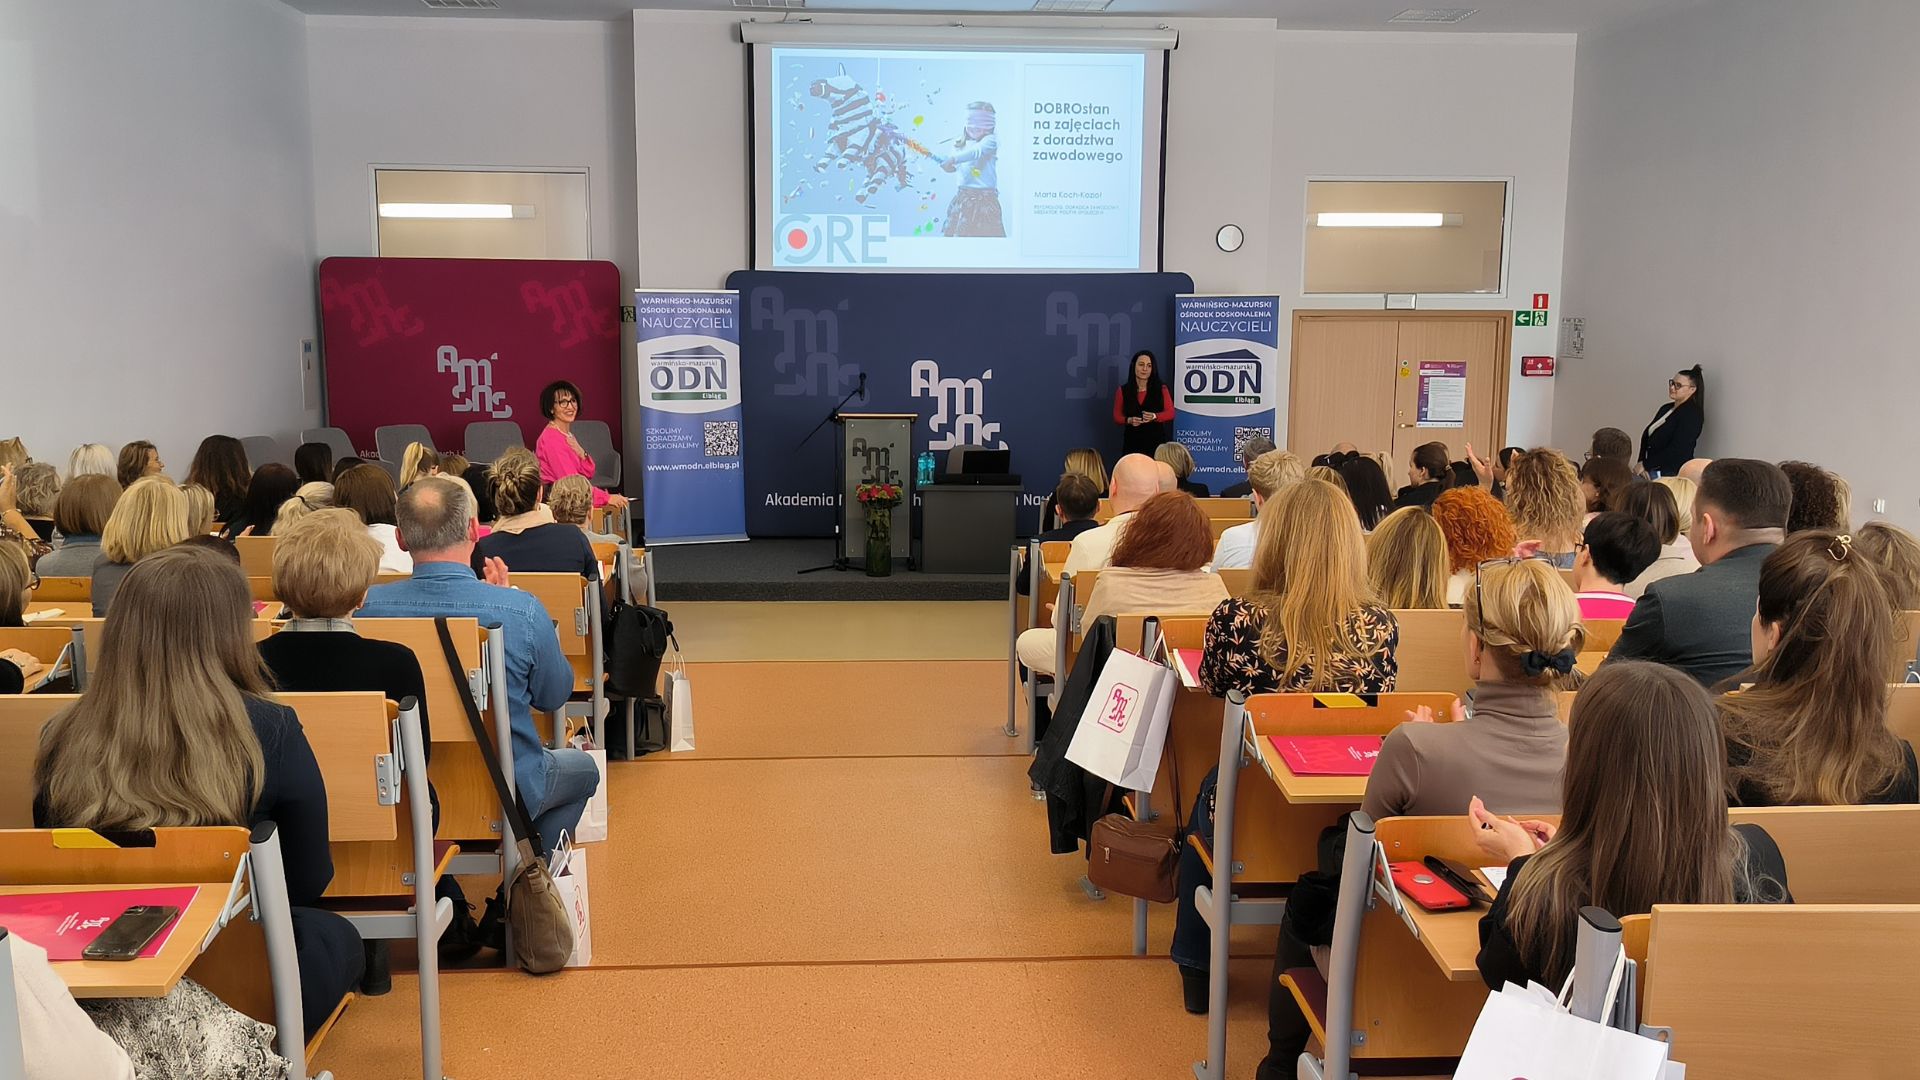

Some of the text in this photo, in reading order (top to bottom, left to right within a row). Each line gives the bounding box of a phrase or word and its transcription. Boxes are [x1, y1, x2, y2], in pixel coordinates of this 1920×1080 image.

[1033, 102, 1110, 114] DOBROstan
[1033, 118, 1120, 132] na zajęciach
[1032, 133, 1114, 145] z doradztwa
[1032, 149, 1123, 163] zawodowego
[774, 213, 888, 264] ORE
[641, 296, 732, 305] WARMIŃSKO-MAZURSKI
[1181, 301, 1272, 309] WARMIŃSKO-MAZURSKI
[642, 317, 733, 329] NAUCZYCIELI
[1180, 321, 1272, 333] NAUCZYCIELI
[650, 366, 727, 390] ODN
[1184, 369, 1262, 394] ODN
[1176, 429, 1213, 437] SZKOLIMY
[646, 442, 700, 450] DOSKONALIMY
[1176, 437, 1223, 445] DORADZAMY
[1186, 444, 1229, 452] SKONALIMY
[765, 493, 834, 506] Akademia
